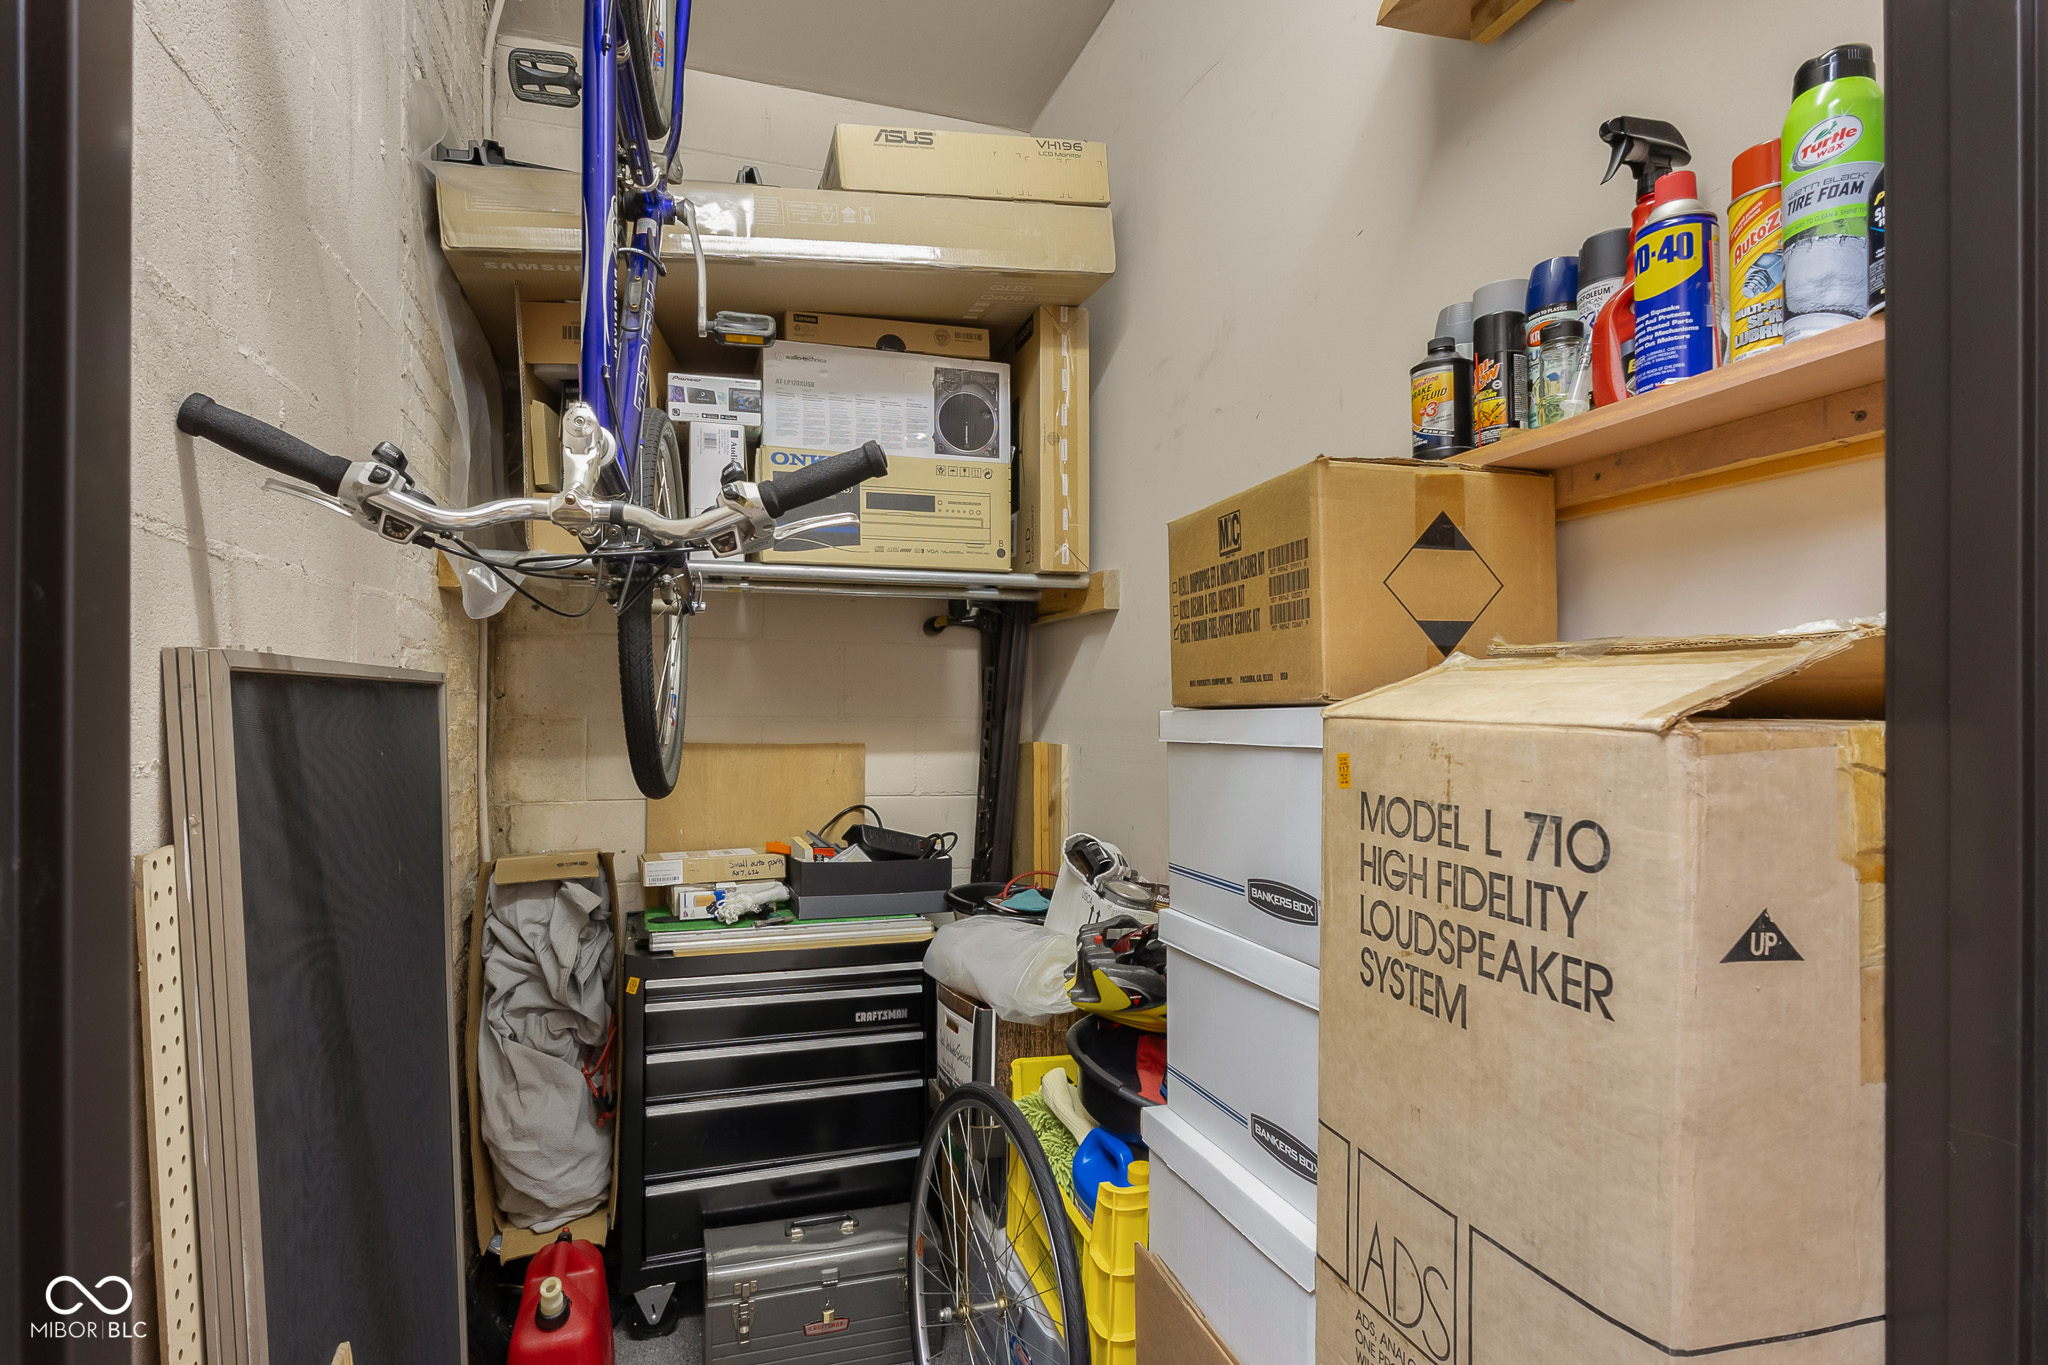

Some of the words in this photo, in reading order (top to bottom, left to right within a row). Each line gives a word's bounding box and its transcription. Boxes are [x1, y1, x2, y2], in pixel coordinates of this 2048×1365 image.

[873, 129, 934, 146] ASUS
[1036, 139, 1084, 152] VH196
[1801, 126, 1858, 160] Turtle
[1787, 190, 1816, 217] TIRE
[1817, 179, 1865, 203] FOAM
[1814, 212, 1833, 222] CLEAN
[1840, 207, 1857, 215] SHINE
[1734, 208, 1782, 269] AutoZ
[989, 284, 1033, 293] QLED
[1645, 317, 1657, 326] And
[1658, 311, 1691, 321] Protects
[1650, 304, 1680, 317] Squeaks
[1646, 321, 1670, 333] Rusted
[1672, 318, 1694, 326] Parts
[1654, 325, 1699, 338] Mechanisms
[1644, 340, 1656, 348] Out
[1657, 334, 1691, 344] Moisture
[785, 354, 828, 364] audio-technica
[1421, 387, 1448, 403] FLUID
[1359, 790, 1470, 852] MODEL
[1484, 808, 1503, 858] L
[1523, 810, 1612, 874] 710
[728, 859, 748, 869] Small
[750, 859, 765, 867] auto
[767, 857, 785, 871] parts
[1359, 842, 1427, 900] HIGH
[1436, 860, 1589, 939] FIDELITY
[1251, 886, 1292, 910] BANKERS
[1292, 900, 1314, 917] BOX
[1750, 931, 1778, 956] UP
[1359, 894, 1616, 1023] LOUDSPEAKER
[1359, 946, 1468, 1031] SYSTEM
[855, 1008, 908, 1022] CRAFTSMAN
[1254, 1122, 1298, 1161] BANKERS
[1361, 1220, 1451, 1361] ADS
[1355, 1309, 1377, 1341] ADS,
[1355, 1328, 1376, 1358] ONE
